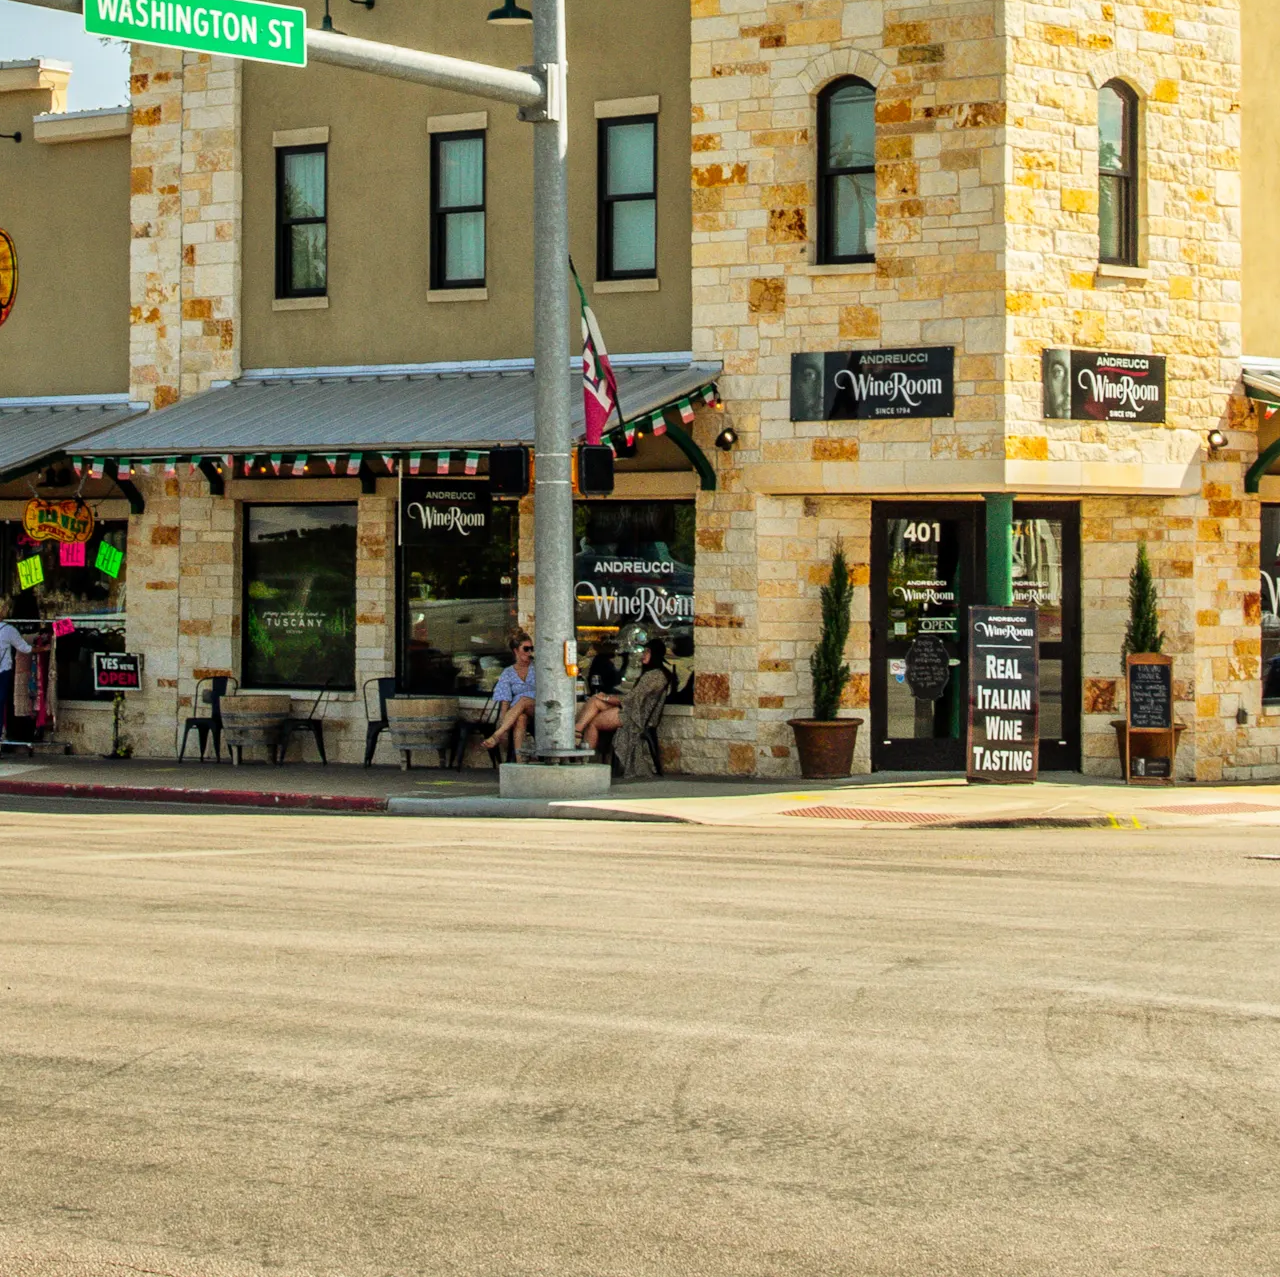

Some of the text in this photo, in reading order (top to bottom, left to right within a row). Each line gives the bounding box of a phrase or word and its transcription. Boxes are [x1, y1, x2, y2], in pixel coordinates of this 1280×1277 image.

[268, 19, 294, 49] ST
[859, 353, 928, 365] ANDREUCCI
[1096, 356, 1149, 370] ANDREUCCI
[875, 407, 895, 415] SINCE
[1109, 410, 1125, 418] SINCE
[426, 491, 476, 500] ANDREUCCI
[903, 522, 941, 542] 401
[594, 561, 674, 573] ANDREUCCI
[266, 618, 323, 627] TUSCANY
[921, 620, 954, 630] OPEN
[100, 657, 119, 670] YES
[986, 655, 1022, 679] REAL
[98, 671, 138, 685] OPEN
[977, 685, 1031, 710] ITALIAN
[985, 716, 1023, 741] WINE
[973, 746, 1033, 772] TASTING
